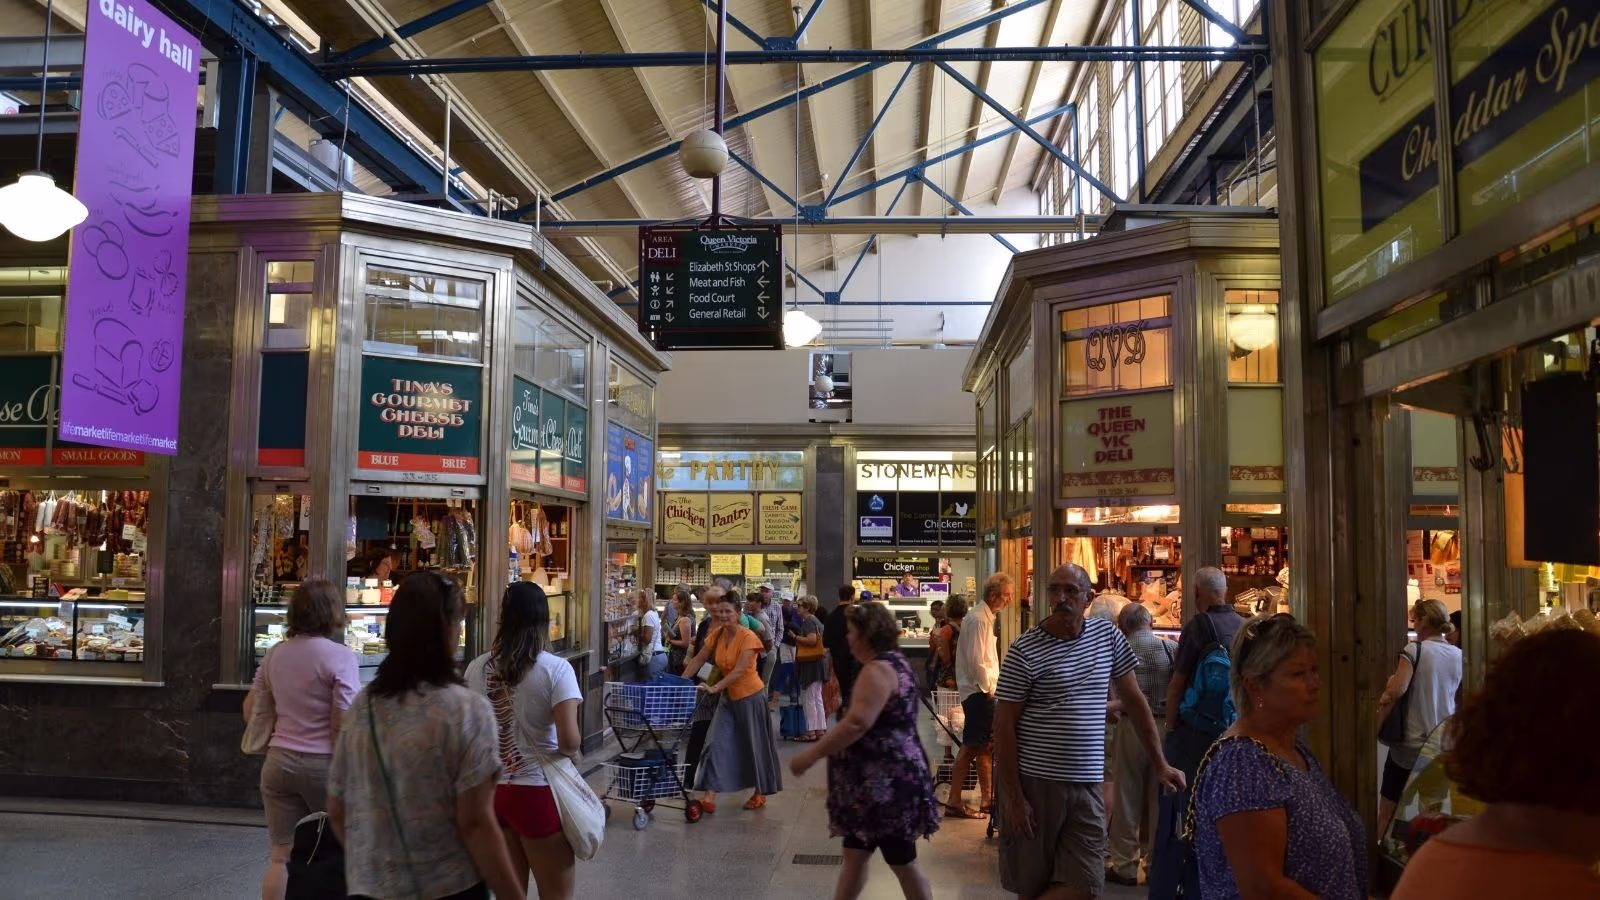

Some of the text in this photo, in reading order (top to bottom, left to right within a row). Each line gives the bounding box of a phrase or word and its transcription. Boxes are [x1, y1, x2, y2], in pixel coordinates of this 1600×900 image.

[99, 0, 193, 73] dairy hall
[700, 234, 758, 247] Queen Victoria
[648, 247, 676, 259] DELI
[689, 261, 756, 274] Elizabeth St Shops
[689, 277, 746, 288] Meat and Fish
[689, 293, 736, 303] Food Court
[689, 308, 746, 319] General Retail
[391, 378, 454, 396] TINA'S
[370, 392, 473, 413] GOURMET
[522, 389, 538, 417] Tina's
[380, 408, 465, 427] CHEESE
[1097, 405, 1132, 421] THE
[397, 424, 445, 440] DELI
[1086, 418, 1146, 438] QUEEN
[567, 427, 582, 459] Deli
[1100, 434, 1130, 449] VIC
[61, 450, 137, 461] SMALL GOODS
[370, 454, 399, 466] BLUE
[1094, 448, 1134, 465] DELI
[441, 458, 467, 469] BRIE
[690, 459, 780, 481] PANTRY
[861, 463, 976, 479] STONEMANS
[678, 496, 692, 504] The
[666, 504, 751, 529] Chicken Pantry
[924, 519, 963, 529] Chicken
[883, 562, 915, 571] Chicken
